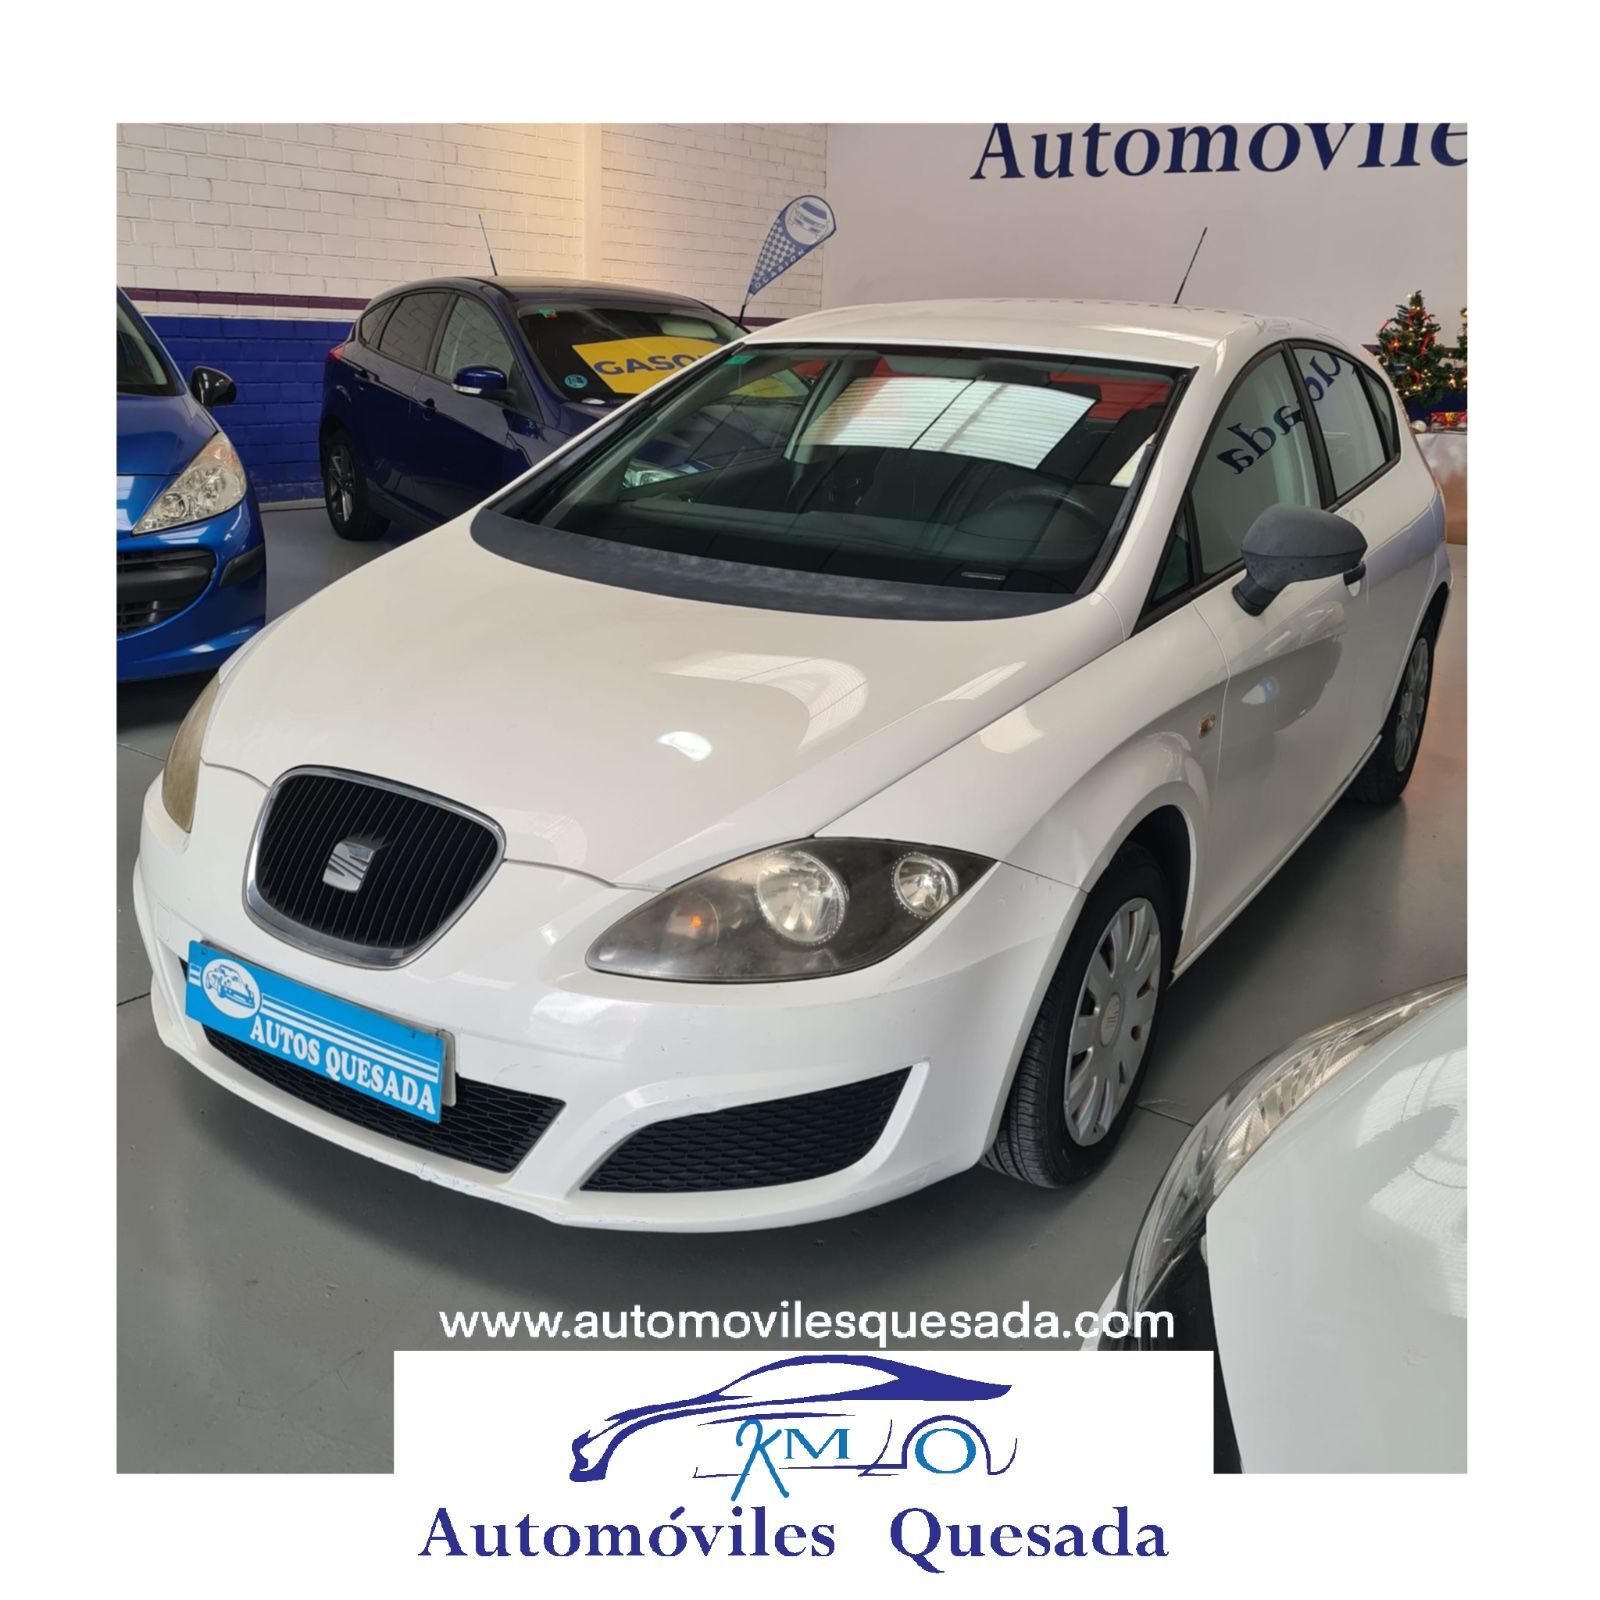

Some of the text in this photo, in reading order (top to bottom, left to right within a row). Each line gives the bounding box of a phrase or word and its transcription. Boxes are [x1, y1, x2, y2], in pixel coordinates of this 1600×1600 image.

[593, 353, 703, 376] GASO
[250, 1015, 436, 1115] AUTOS QUESADA
